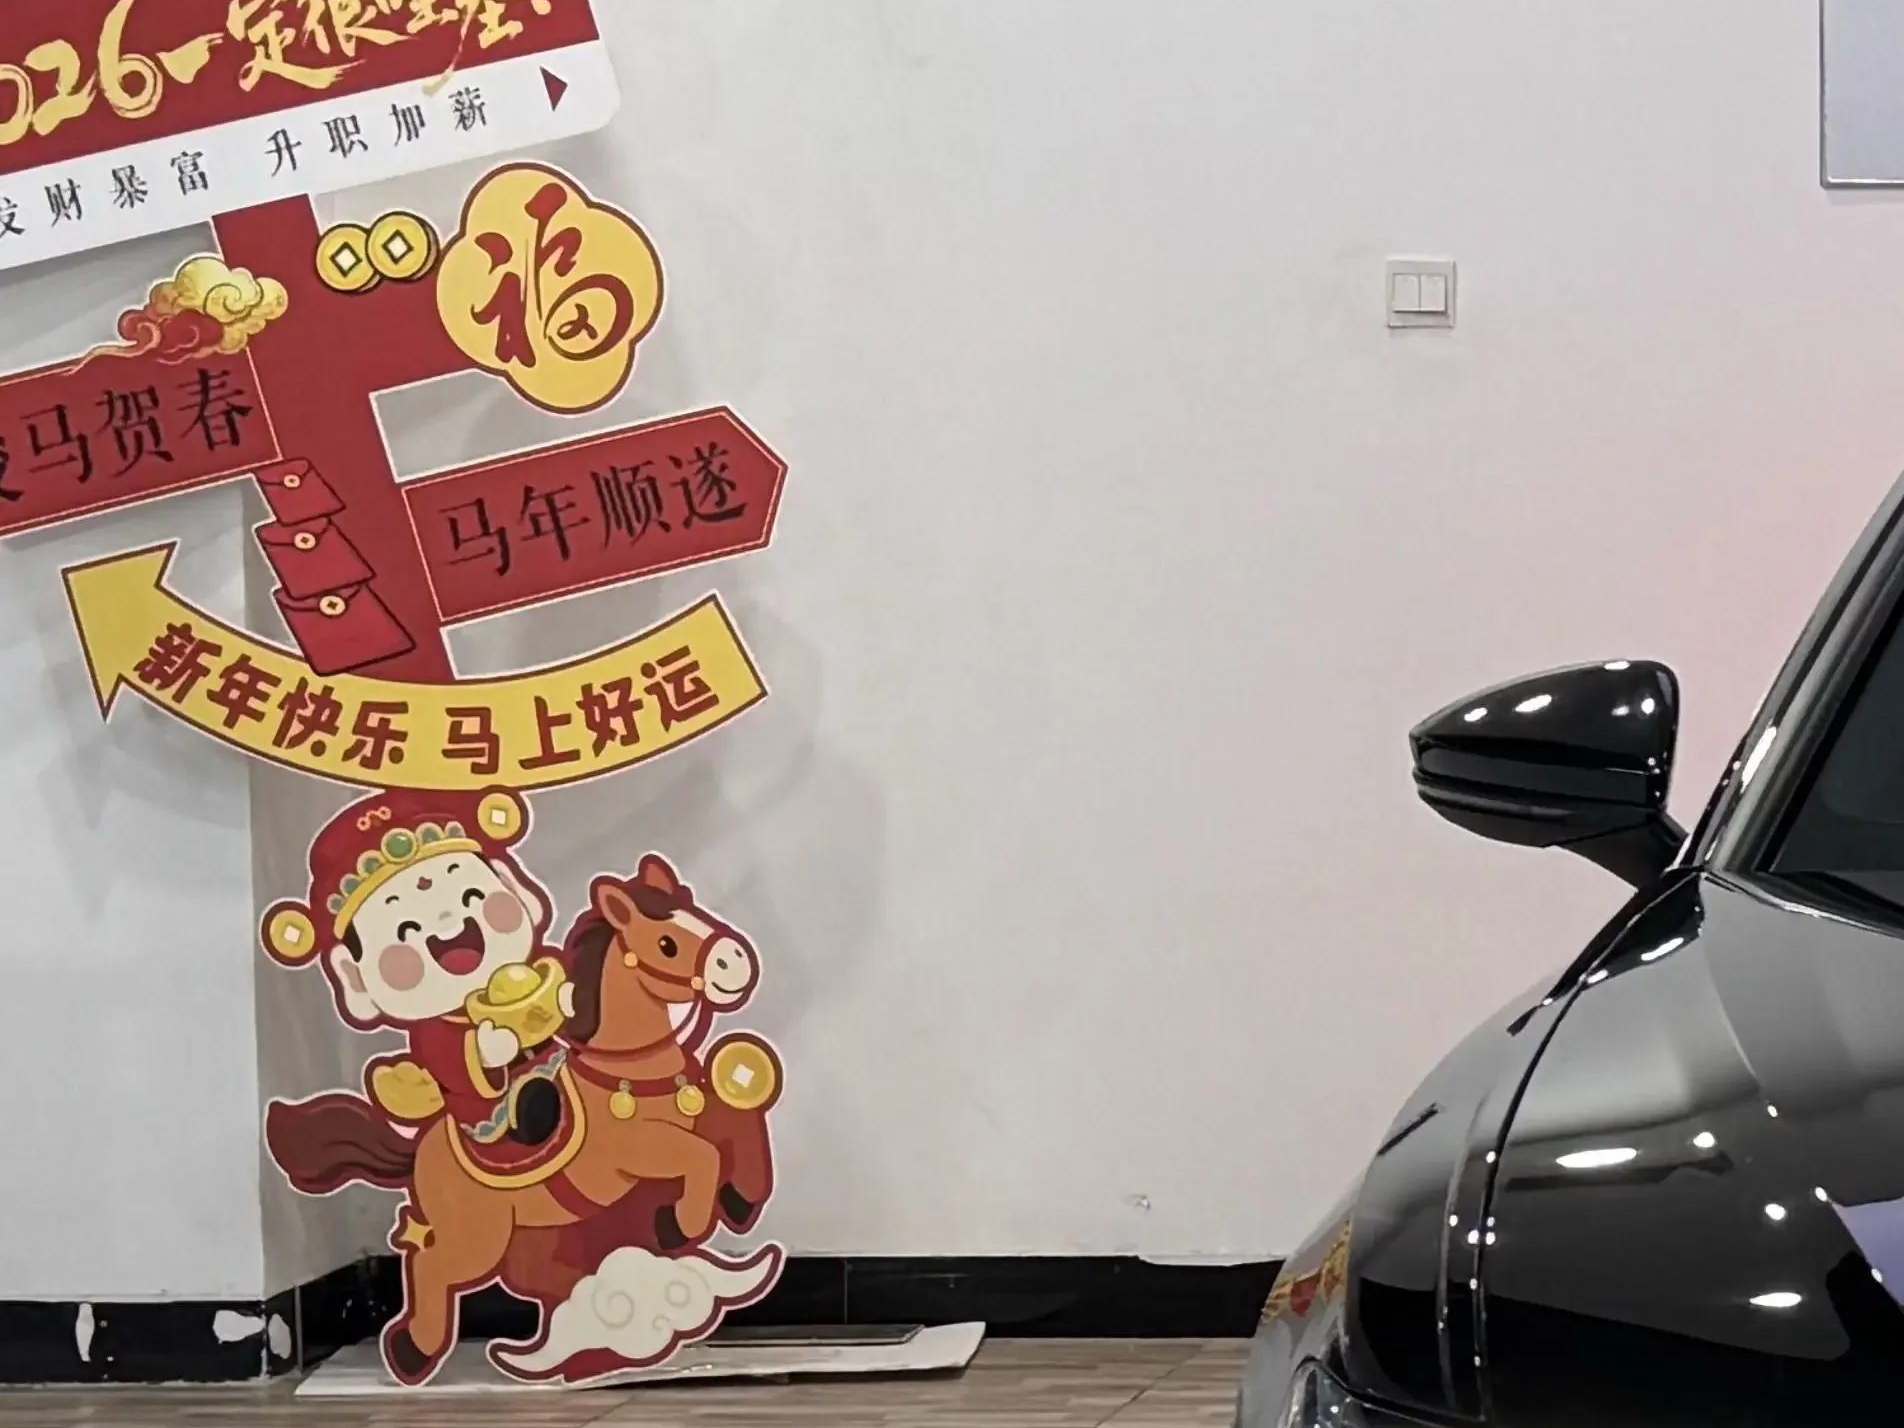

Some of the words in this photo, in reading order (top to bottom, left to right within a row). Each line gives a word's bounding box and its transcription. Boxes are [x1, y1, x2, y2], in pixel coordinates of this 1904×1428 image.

[264, 85, 488, 177] 升职加薪
[470, 182, 635, 369] 福
[444, 440, 747, 578] 马年顺遂
[131, 623, 409, 768] 新年快乐
[442, 646, 720, 775] 马上好运
